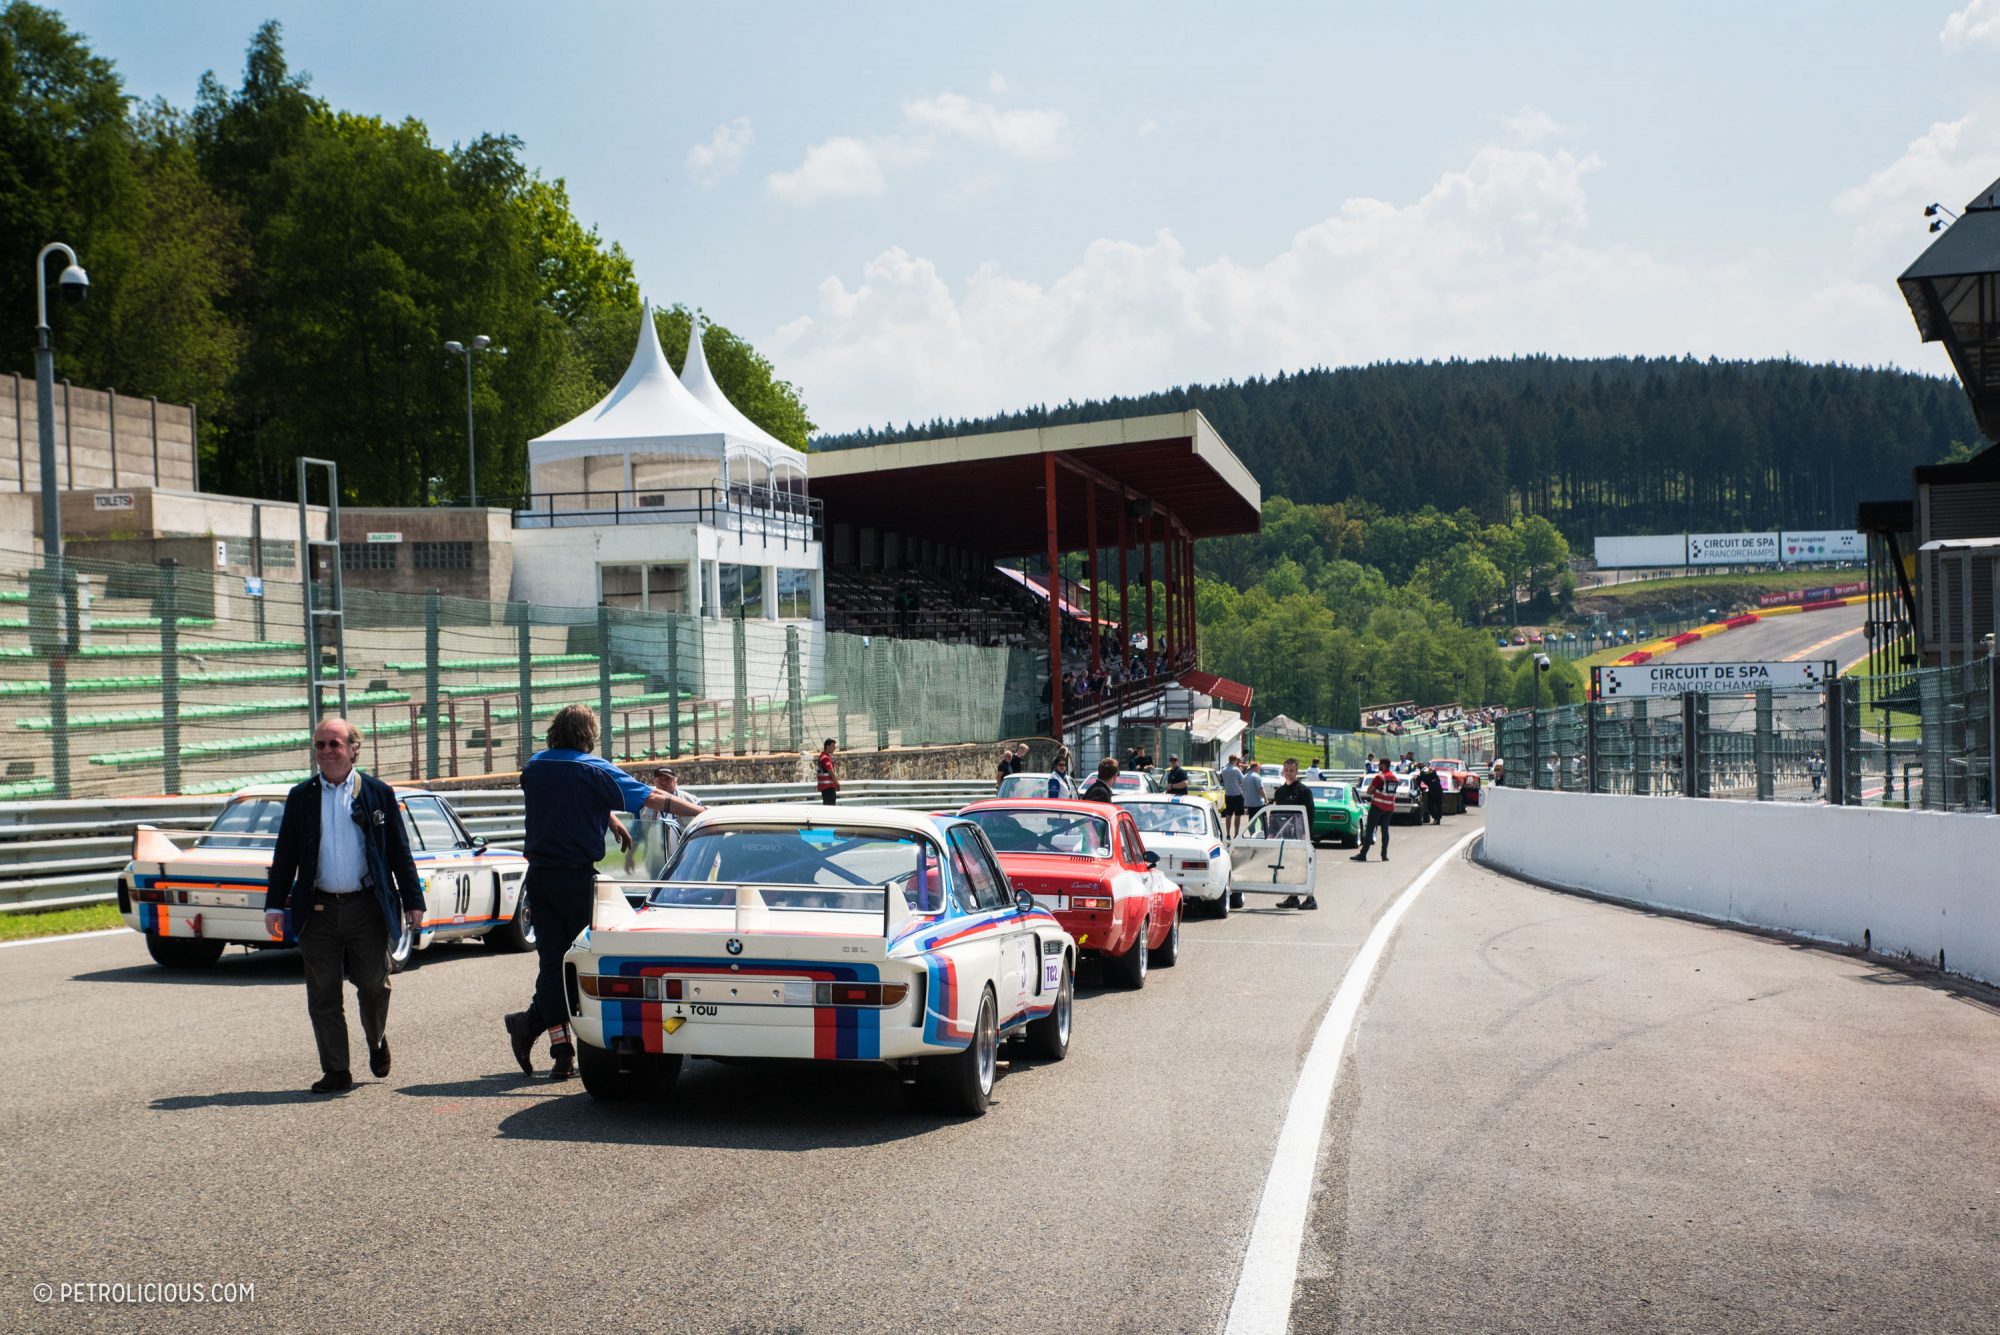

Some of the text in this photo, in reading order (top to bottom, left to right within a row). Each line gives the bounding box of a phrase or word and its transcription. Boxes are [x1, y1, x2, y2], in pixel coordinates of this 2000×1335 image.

[95, 495, 129, 506] TOILETS
[1703, 537, 1775, 549] CIRCUIT DE SPA
[1801, 535, 1826, 543] inspired
[1704, 549, 1776, 558] FRANCORCHAMPS
[1650, 666, 1769, 680] CIRCUIT DE SPA
[455, 873, 471, 914] 10
[842, 945, 868, 953] CSL
[1021, 950, 1027, 989] 3
[1046, 965, 1058, 982] TC2
[690, 1005, 718, 1016] TOW
